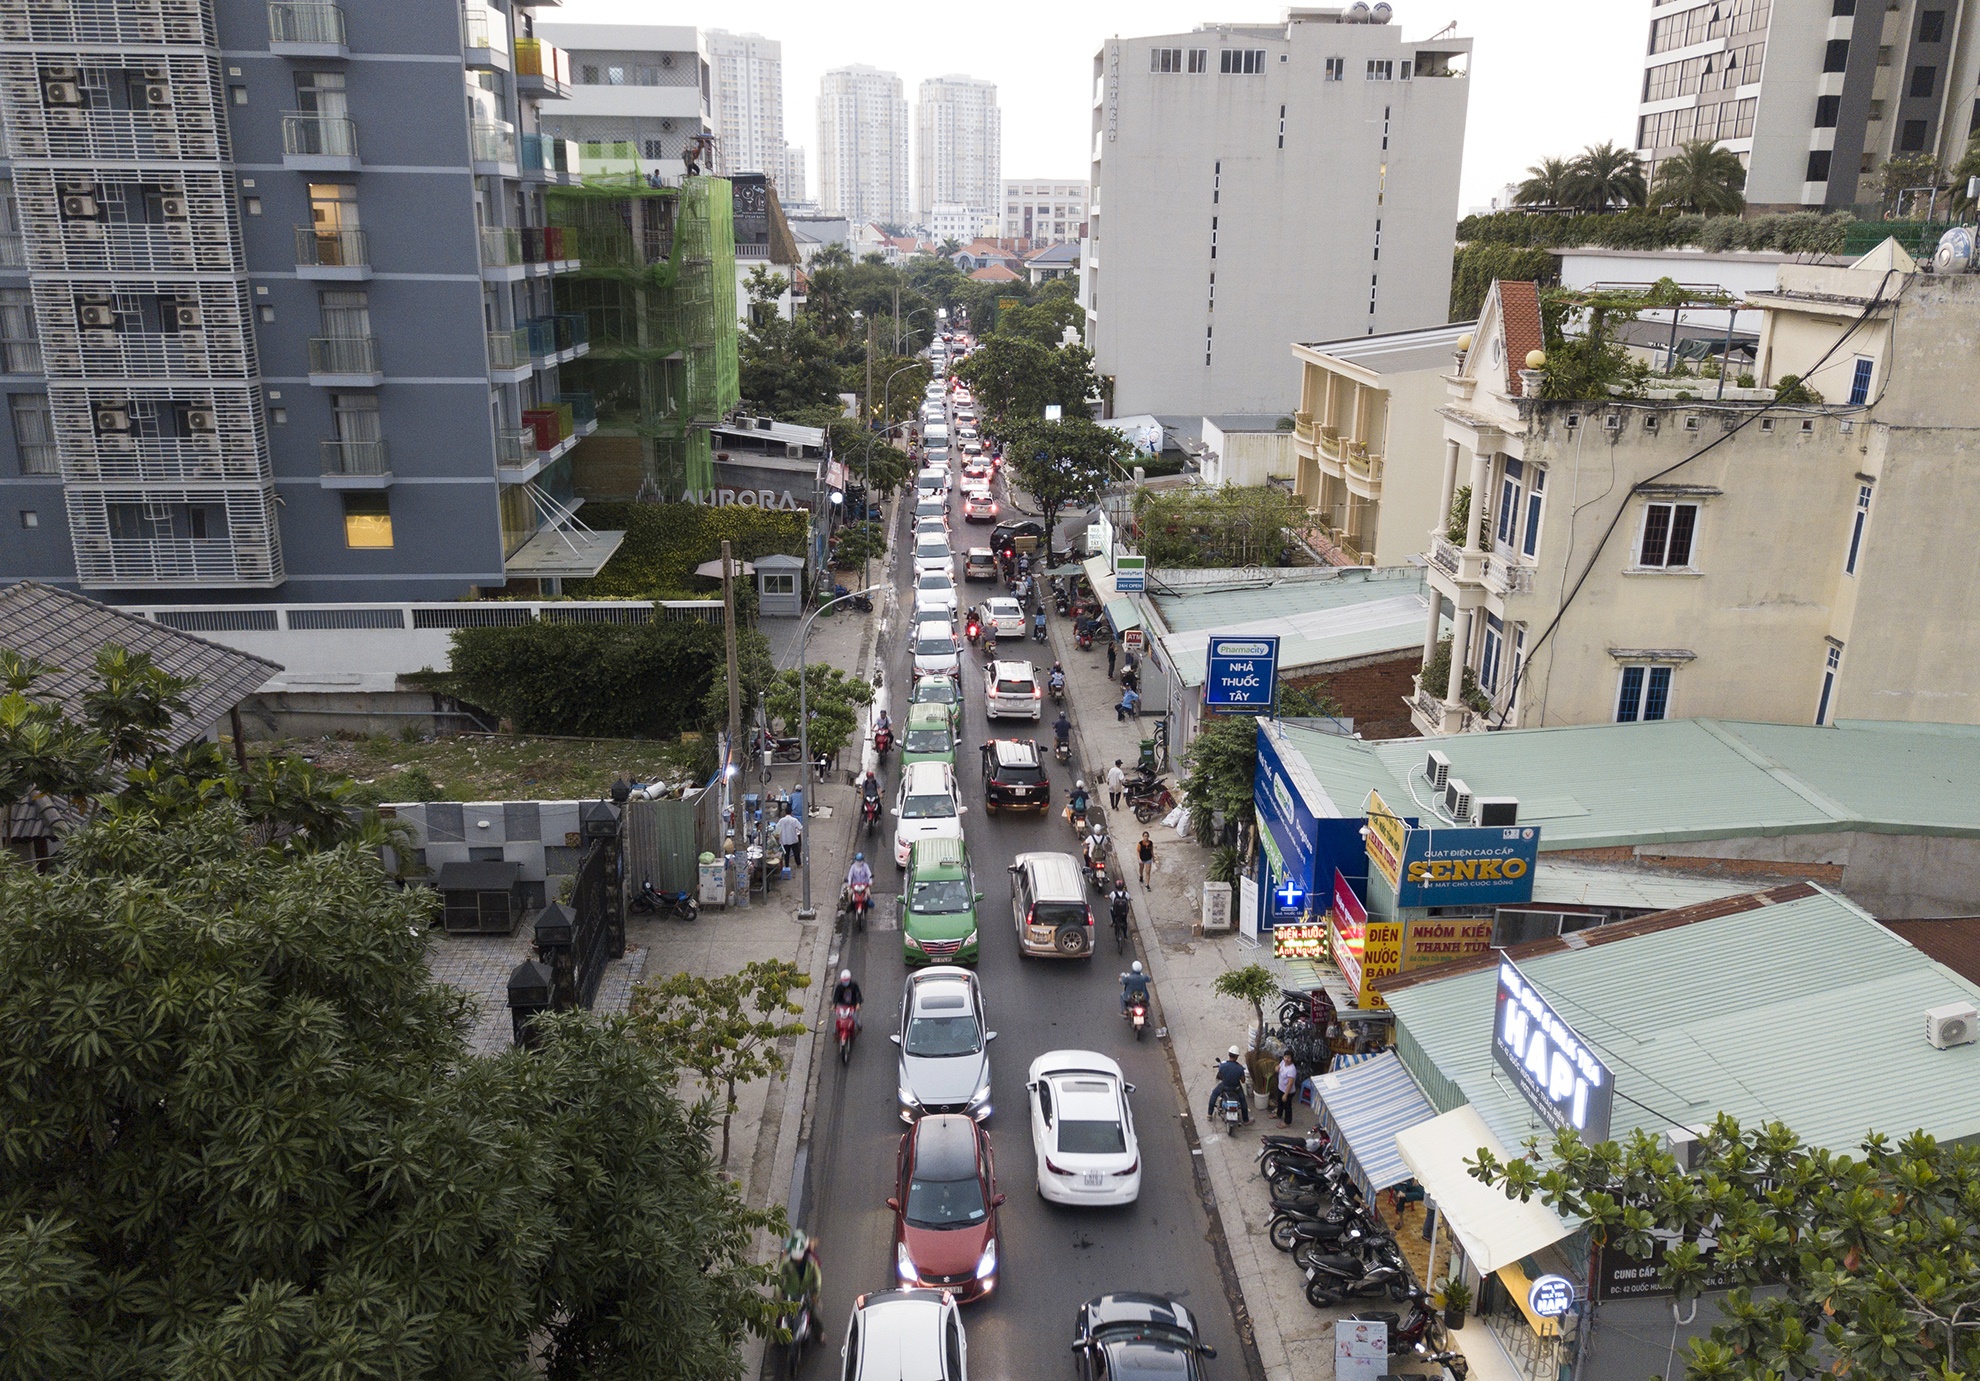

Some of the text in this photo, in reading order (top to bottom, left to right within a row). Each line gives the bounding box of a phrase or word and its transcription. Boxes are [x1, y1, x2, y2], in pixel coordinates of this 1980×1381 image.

[681, 489, 798, 511] AURORA
[1221, 644, 1265, 654] Pharmacity
[1229, 661, 1254, 672] NHÀ
[1221, 674, 1260, 687] THUỐC
[1229, 690, 1250, 701] TÂY
[1424, 850, 1449, 858] QUẠT
[1450, 849, 1472, 857] ĐIỆN
[1494, 847, 1514, 856] CẤP
[1407, 857, 1528, 882] SENKO
[1369, 926, 1399, 946] ĐIỆN
[1412, 923, 1455, 938] NHÔM
[1416, 942, 1462, 952] THANH
[1364, 948, 1399, 964] NƯỚC
[1366, 966, 1397, 977] BÁN
[1504, 998, 1589, 1130] HAPI
[1614, 1269, 1637, 1280] CUNG
[1638, 1265, 1656, 1277] CẤP
[1623, 1285, 1630, 1293] 42
[1631, 1282, 1649, 1293] QUỐC
[1537, 1297, 1568, 1312] HAPI
